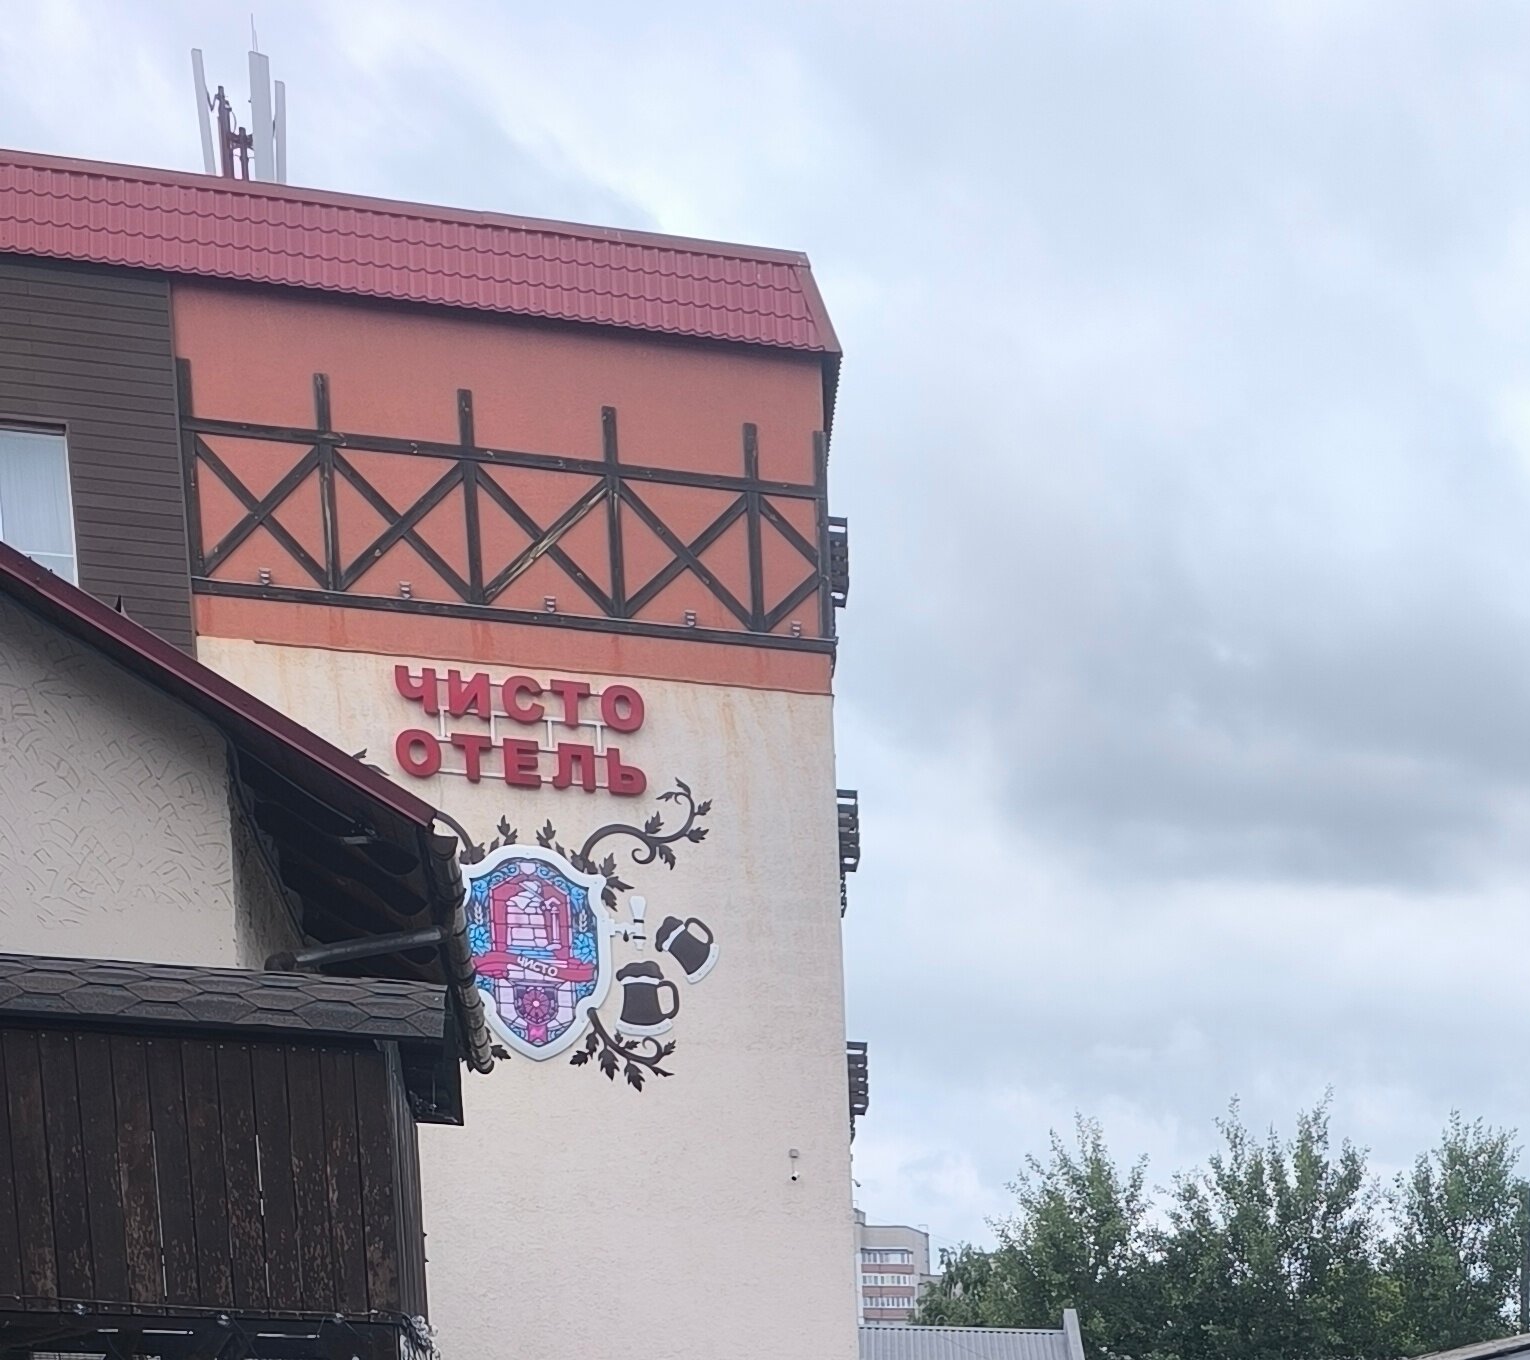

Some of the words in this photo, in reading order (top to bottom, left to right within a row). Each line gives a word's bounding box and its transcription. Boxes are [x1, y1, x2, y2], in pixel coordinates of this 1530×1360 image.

[394, 664, 645, 733] ЧИСТО
[395, 728, 647, 796] ОТЕЛЬ
[516, 956, 559, 977] ЧИСТО
